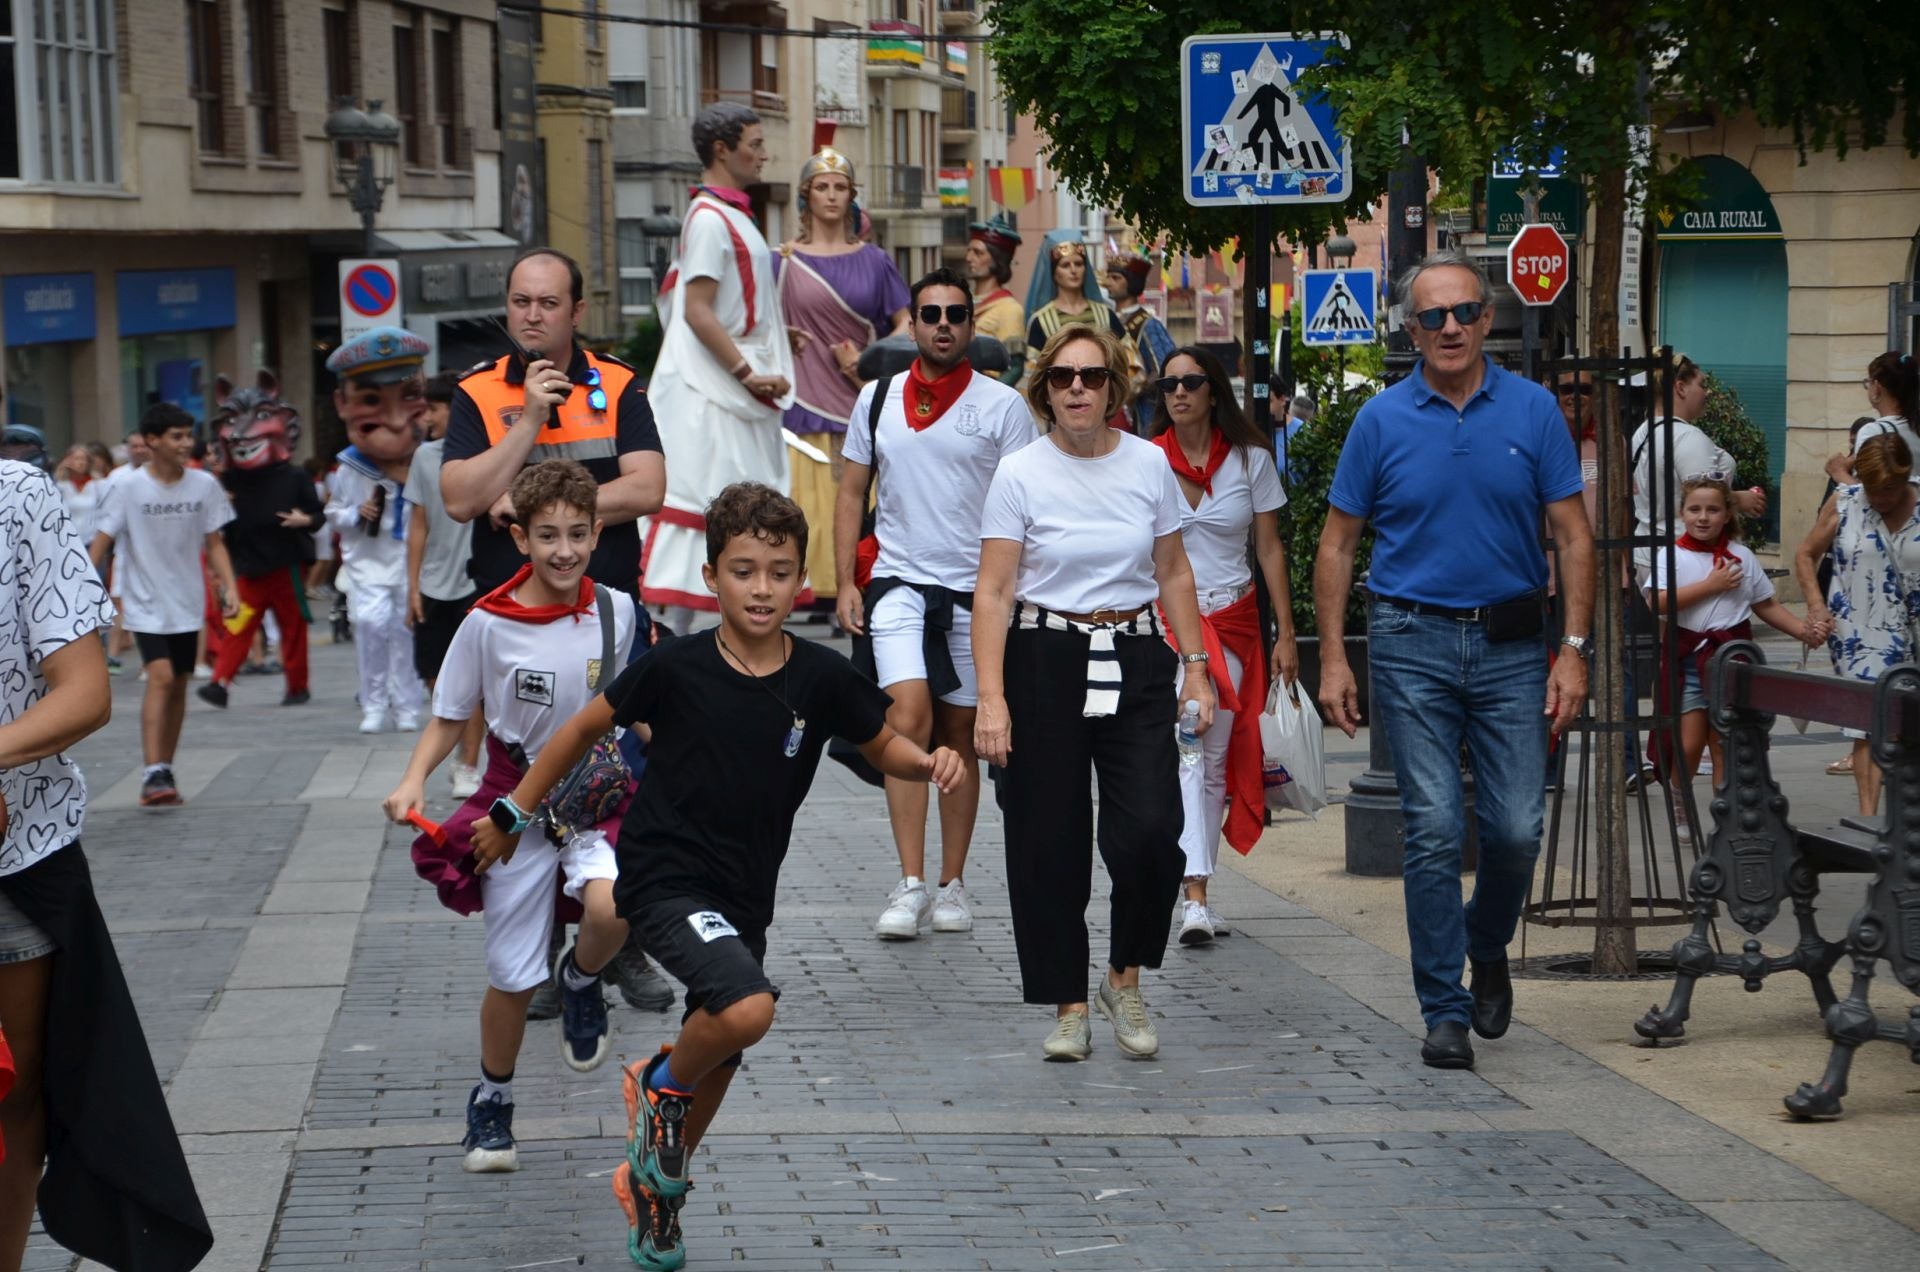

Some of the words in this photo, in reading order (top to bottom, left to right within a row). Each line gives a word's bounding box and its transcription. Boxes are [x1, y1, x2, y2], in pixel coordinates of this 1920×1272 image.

[1502, 161, 1525, 174] WC
[1496, 222, 1513, 232] DE
[1684, 211, 1717, 230] CAJA
[1719, 211, 1767, 228] RURAL
[1516, 255, 1563, 275] STOP
